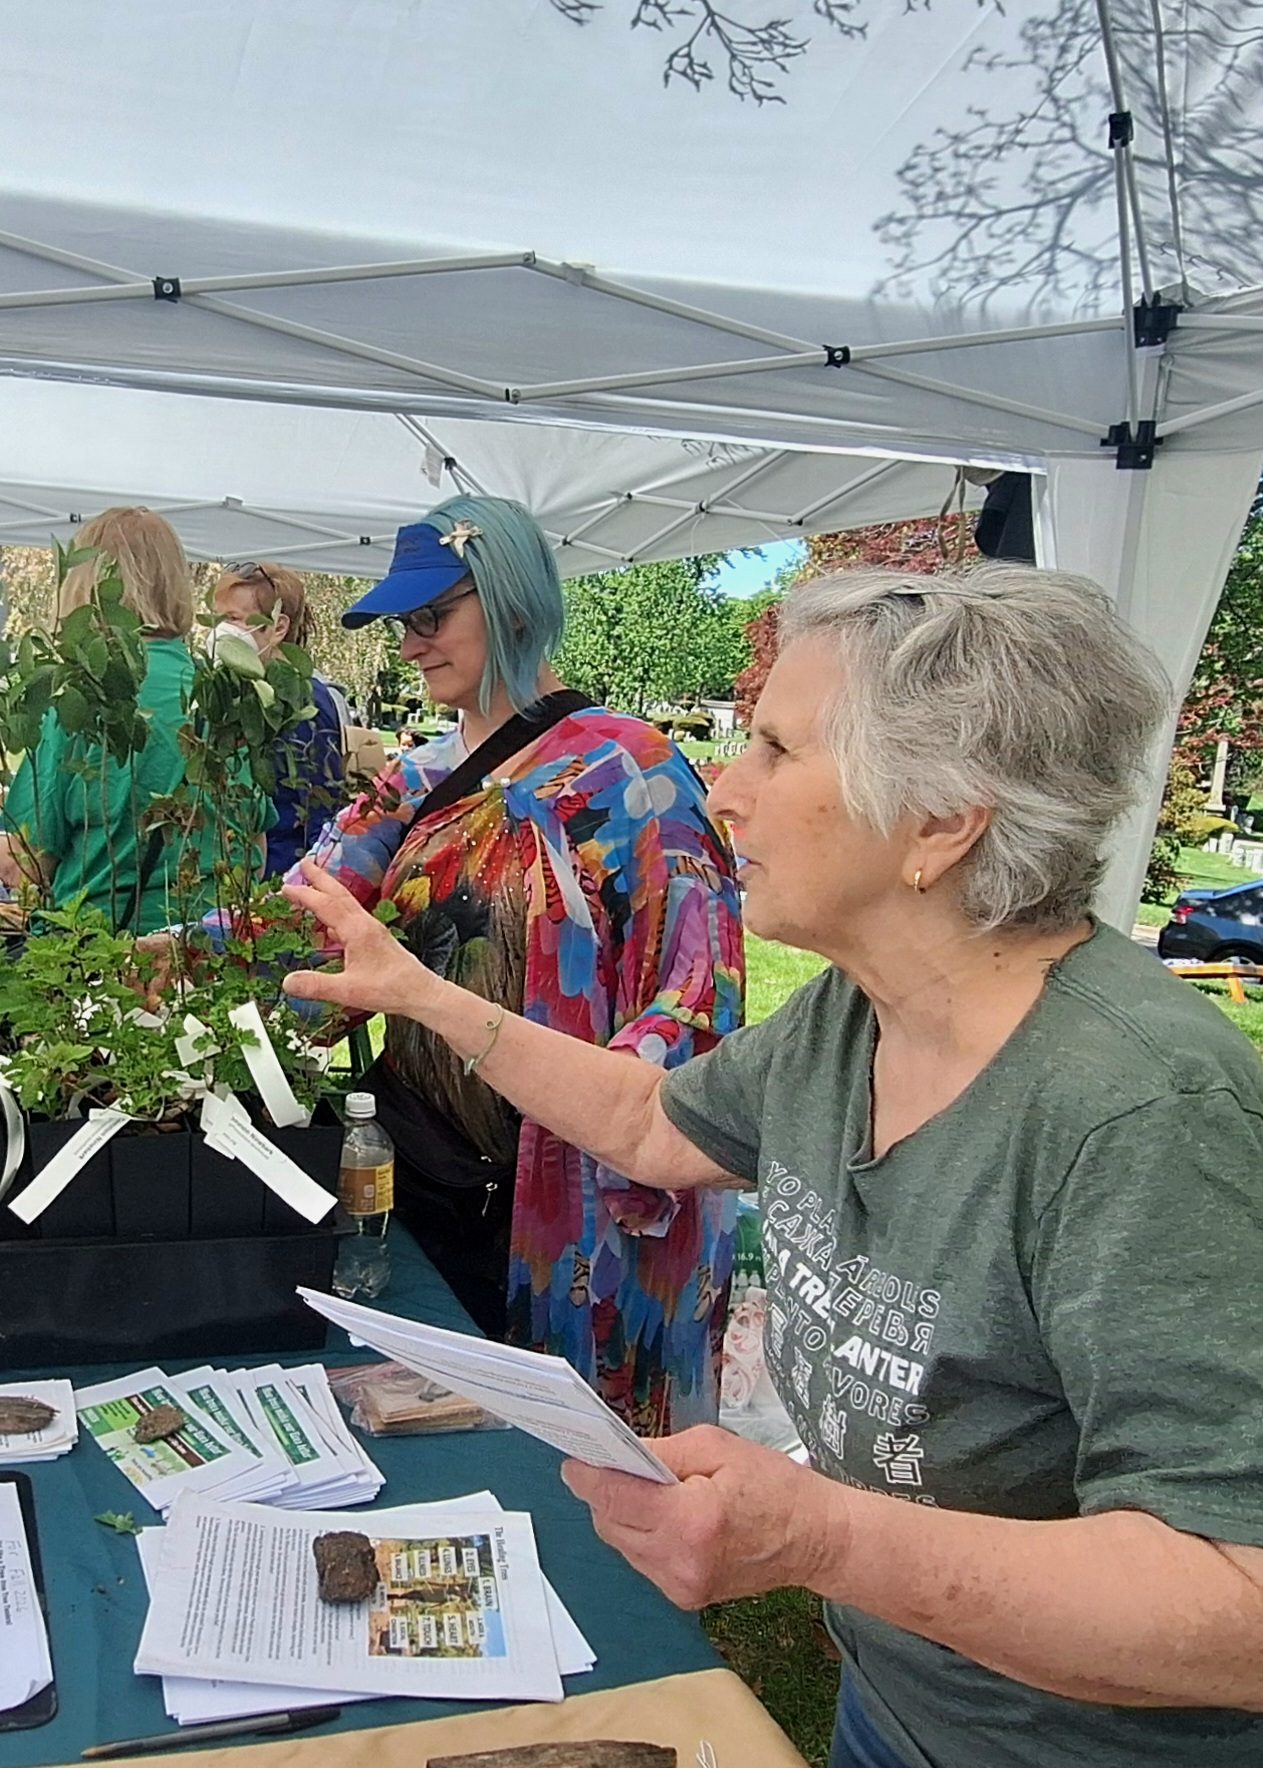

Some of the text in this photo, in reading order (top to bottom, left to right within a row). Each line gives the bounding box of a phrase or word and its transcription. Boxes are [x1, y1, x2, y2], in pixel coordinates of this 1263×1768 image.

[766, 1161, 801, 1196] YO
[797, 1191, 838, 1236] PLA
[768, 1199, 837, 1271] САЖА
[823, 1358, 931, 1427] VORES
[830, 1335, 924, 1395] ANTER
[466, 1557, 476, 1573] EYES
[494, 1526, 504, 1538] The
[499, 1564, 511, 1581] Trees
[483, 1585, 493, 1607] BRAIN
[422, 1624, 432, 1646] TOUCH
[447, 1622, 458, 1643] HEART
